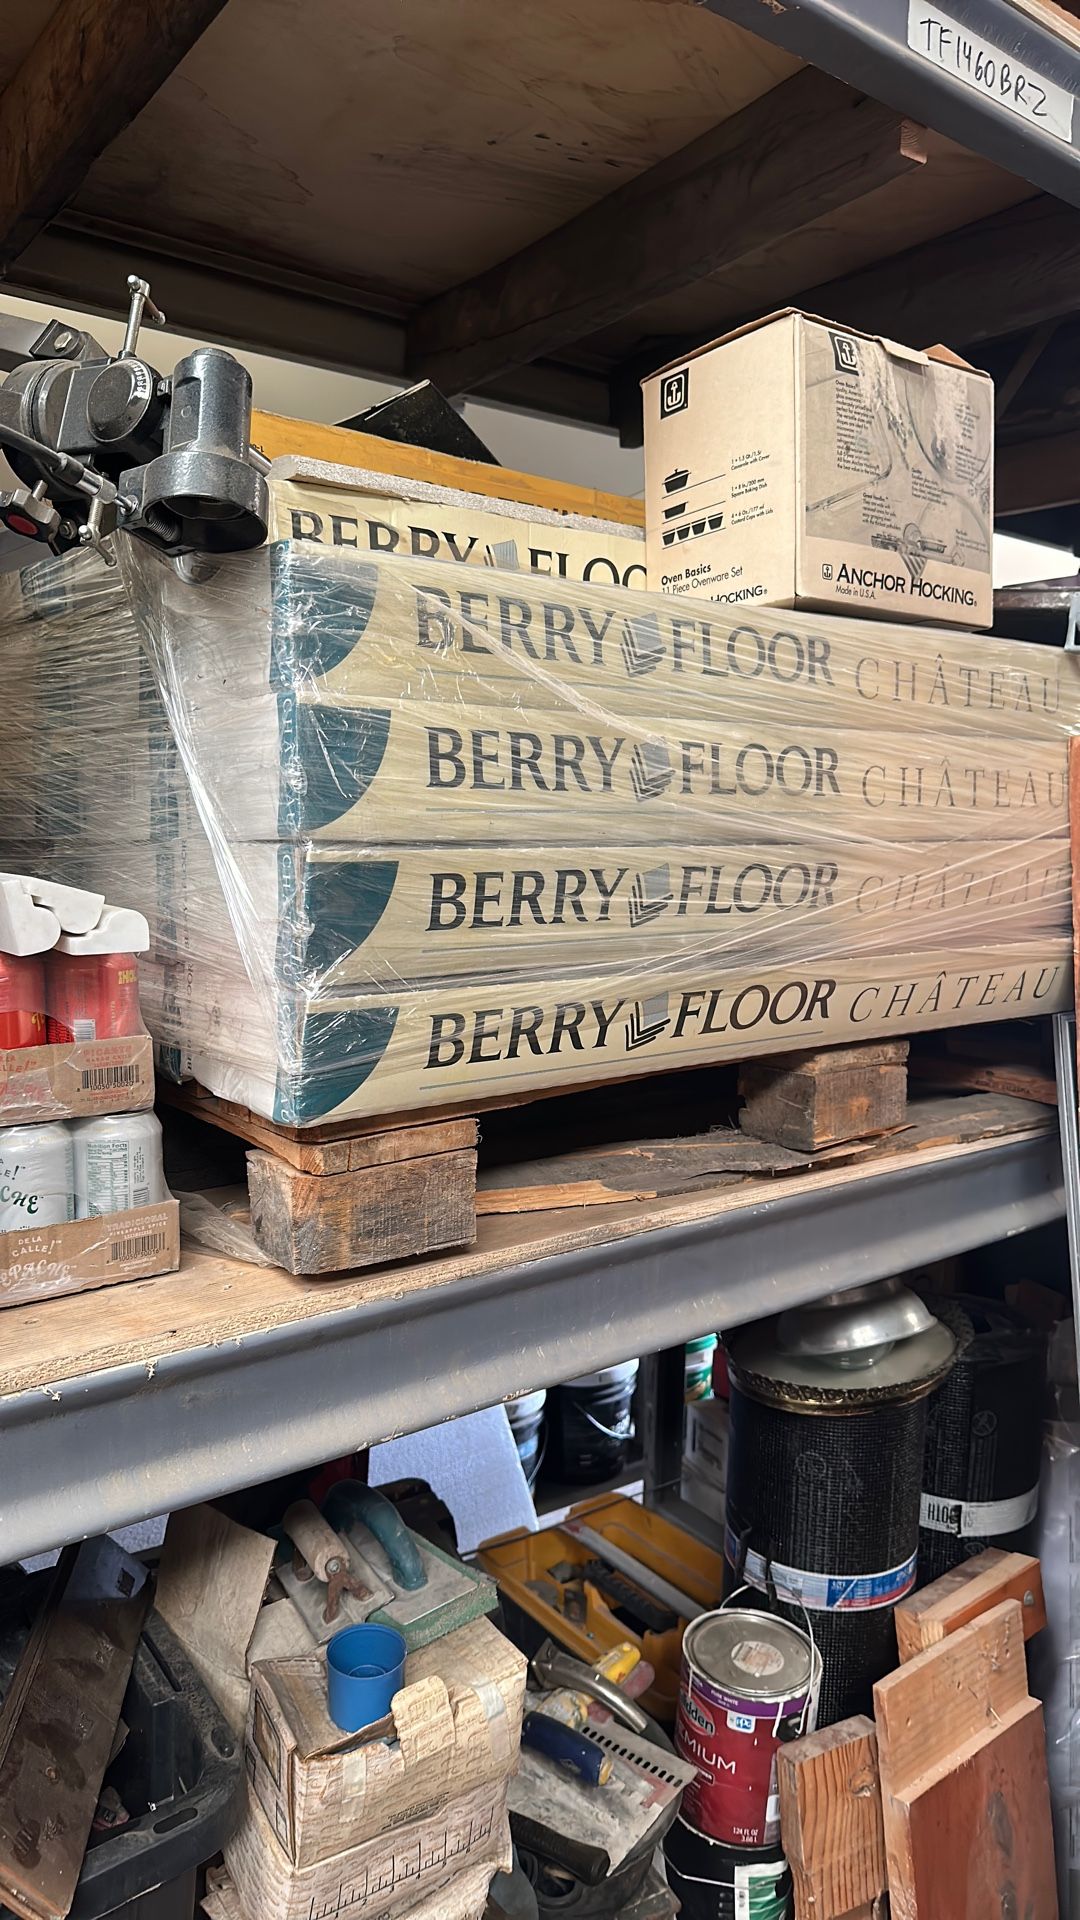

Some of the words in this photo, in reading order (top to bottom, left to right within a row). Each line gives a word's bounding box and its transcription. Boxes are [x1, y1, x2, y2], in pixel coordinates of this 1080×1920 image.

[661, 572, 683, 586] Oven
[685, 563, 712, 579] Basics
[672, 581, 690, 595] Piece
[691, 572, 730, 588] Ovenware
[730, 565, 744, 579] Set
[836, 563, 906, 594] ANCHOR
[910, 577, 975, 606] HOCKING
[835, 585, 852, 596] Made
[411, 584, 617, 666] BERRY
[669, 618, 836, 687] FLOOR
[855, 653, 1060, 714] CHÂTEAU
[424, 726, 627, 792] BERRY
[679, 740, 842, 797] FLOOR
[861, 755, 1066, 808] CHÂTEAU
[425, 868, 630, 932] BERRY
[676, 862, 839, 917] FLOOR
[423, 997, 629, 1070] BERRY
[670, 978, 837, 1039] FLOOR
[849, 966, 1060, 1023] CHÂTEAU
[11, 1239, 56, 1258] CALLE!
[18, 1237, 30, 1246] DE
[31, 1235, 42, 1244] LA
[733, 1826, 743, 1835] 124
[750, 1828, 759, 1837] OZ
